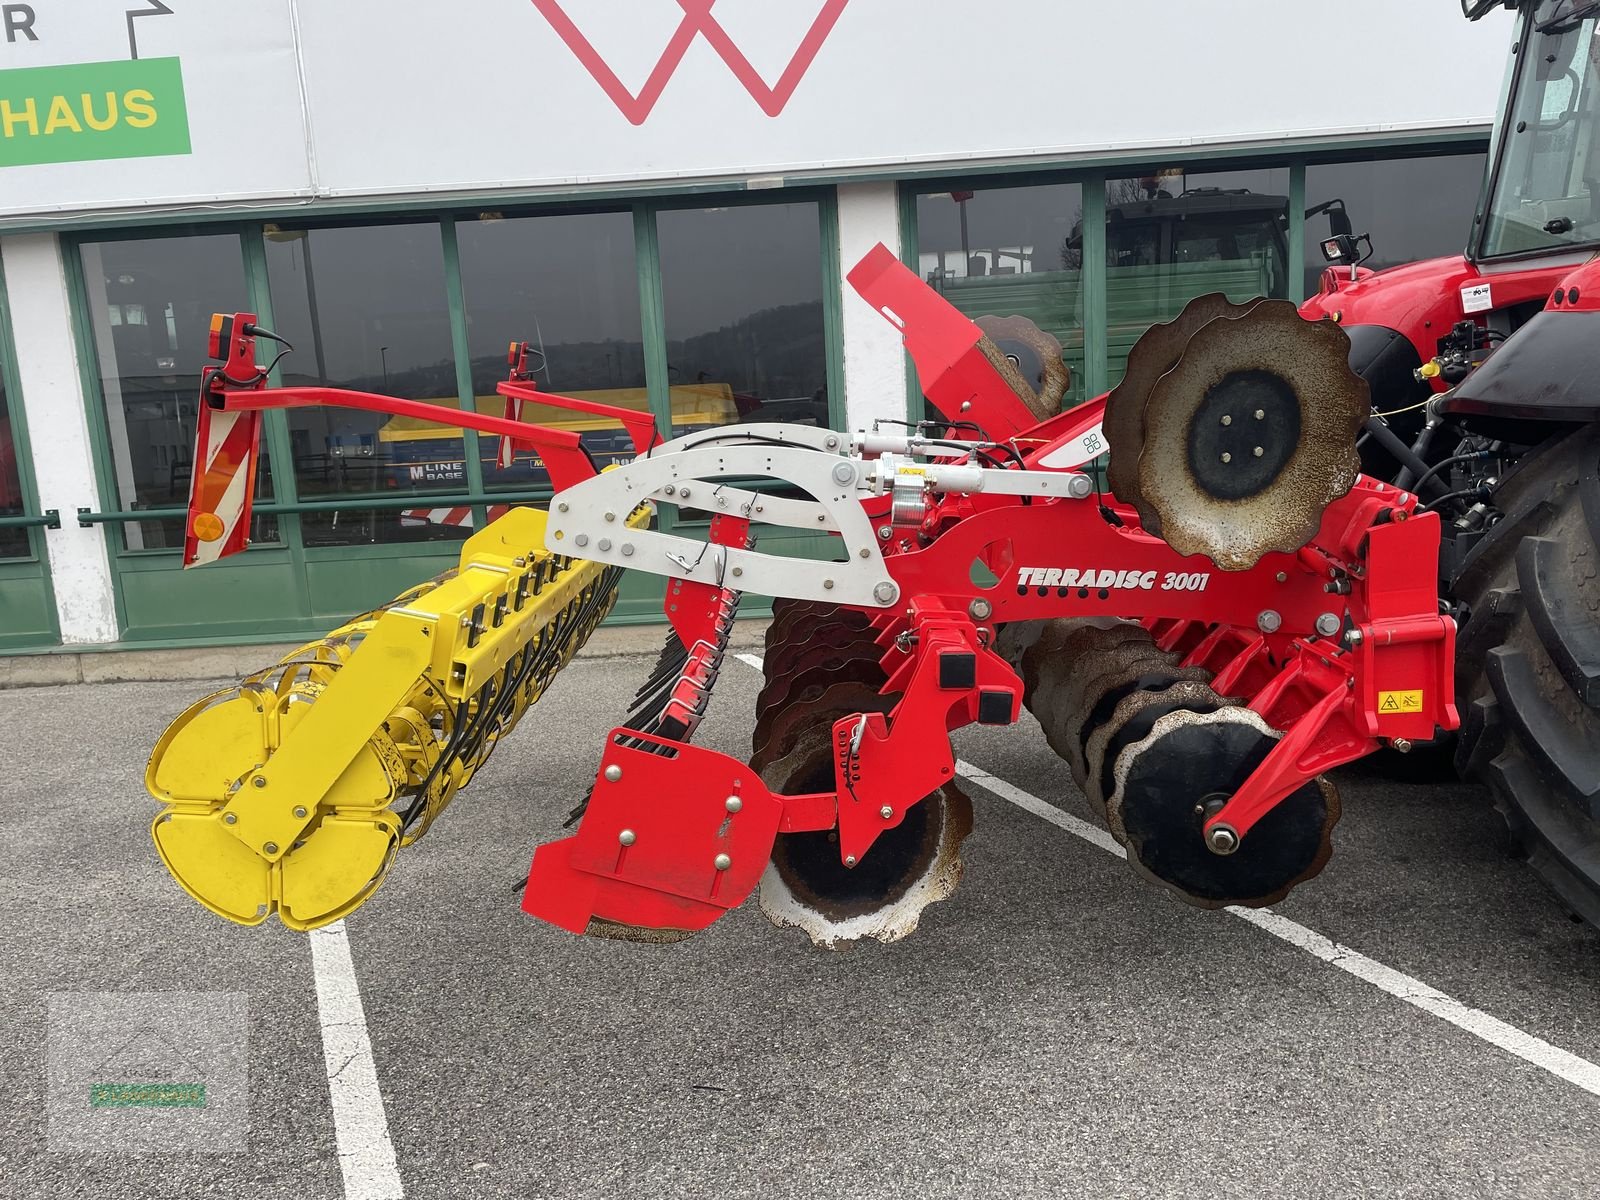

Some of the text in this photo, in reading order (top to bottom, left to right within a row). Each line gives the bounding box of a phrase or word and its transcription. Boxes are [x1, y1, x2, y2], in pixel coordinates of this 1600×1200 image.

[0, 89, 158, 138] HAUS
[425, 463, 462, 471] LINE
[426, 472, 463, 480] BASE
[1017, 567, 1210, 592] TERRADISC 3001
